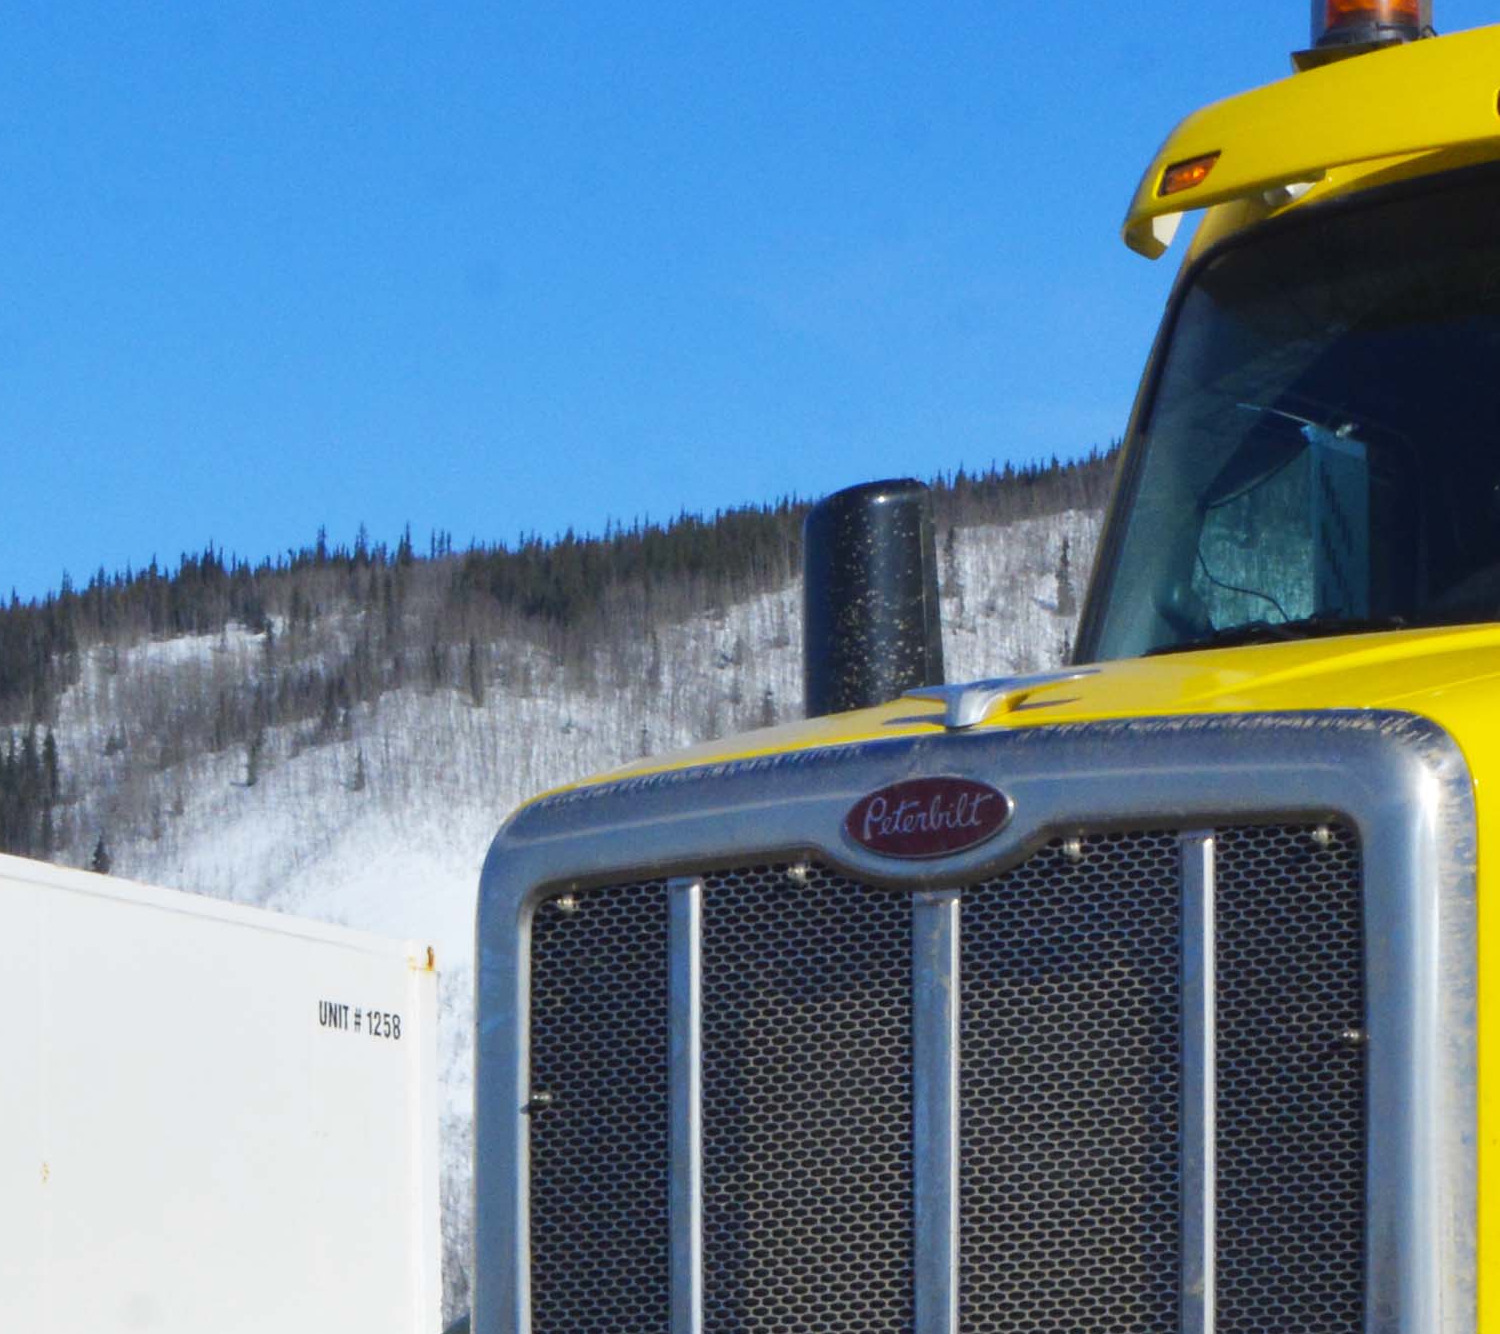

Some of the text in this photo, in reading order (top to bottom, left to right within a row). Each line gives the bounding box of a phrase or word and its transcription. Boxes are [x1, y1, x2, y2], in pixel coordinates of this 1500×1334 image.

[863, 793, 993, 841] Peterbilt
[319, 1000, 401, 1040] UNIT # 1258
